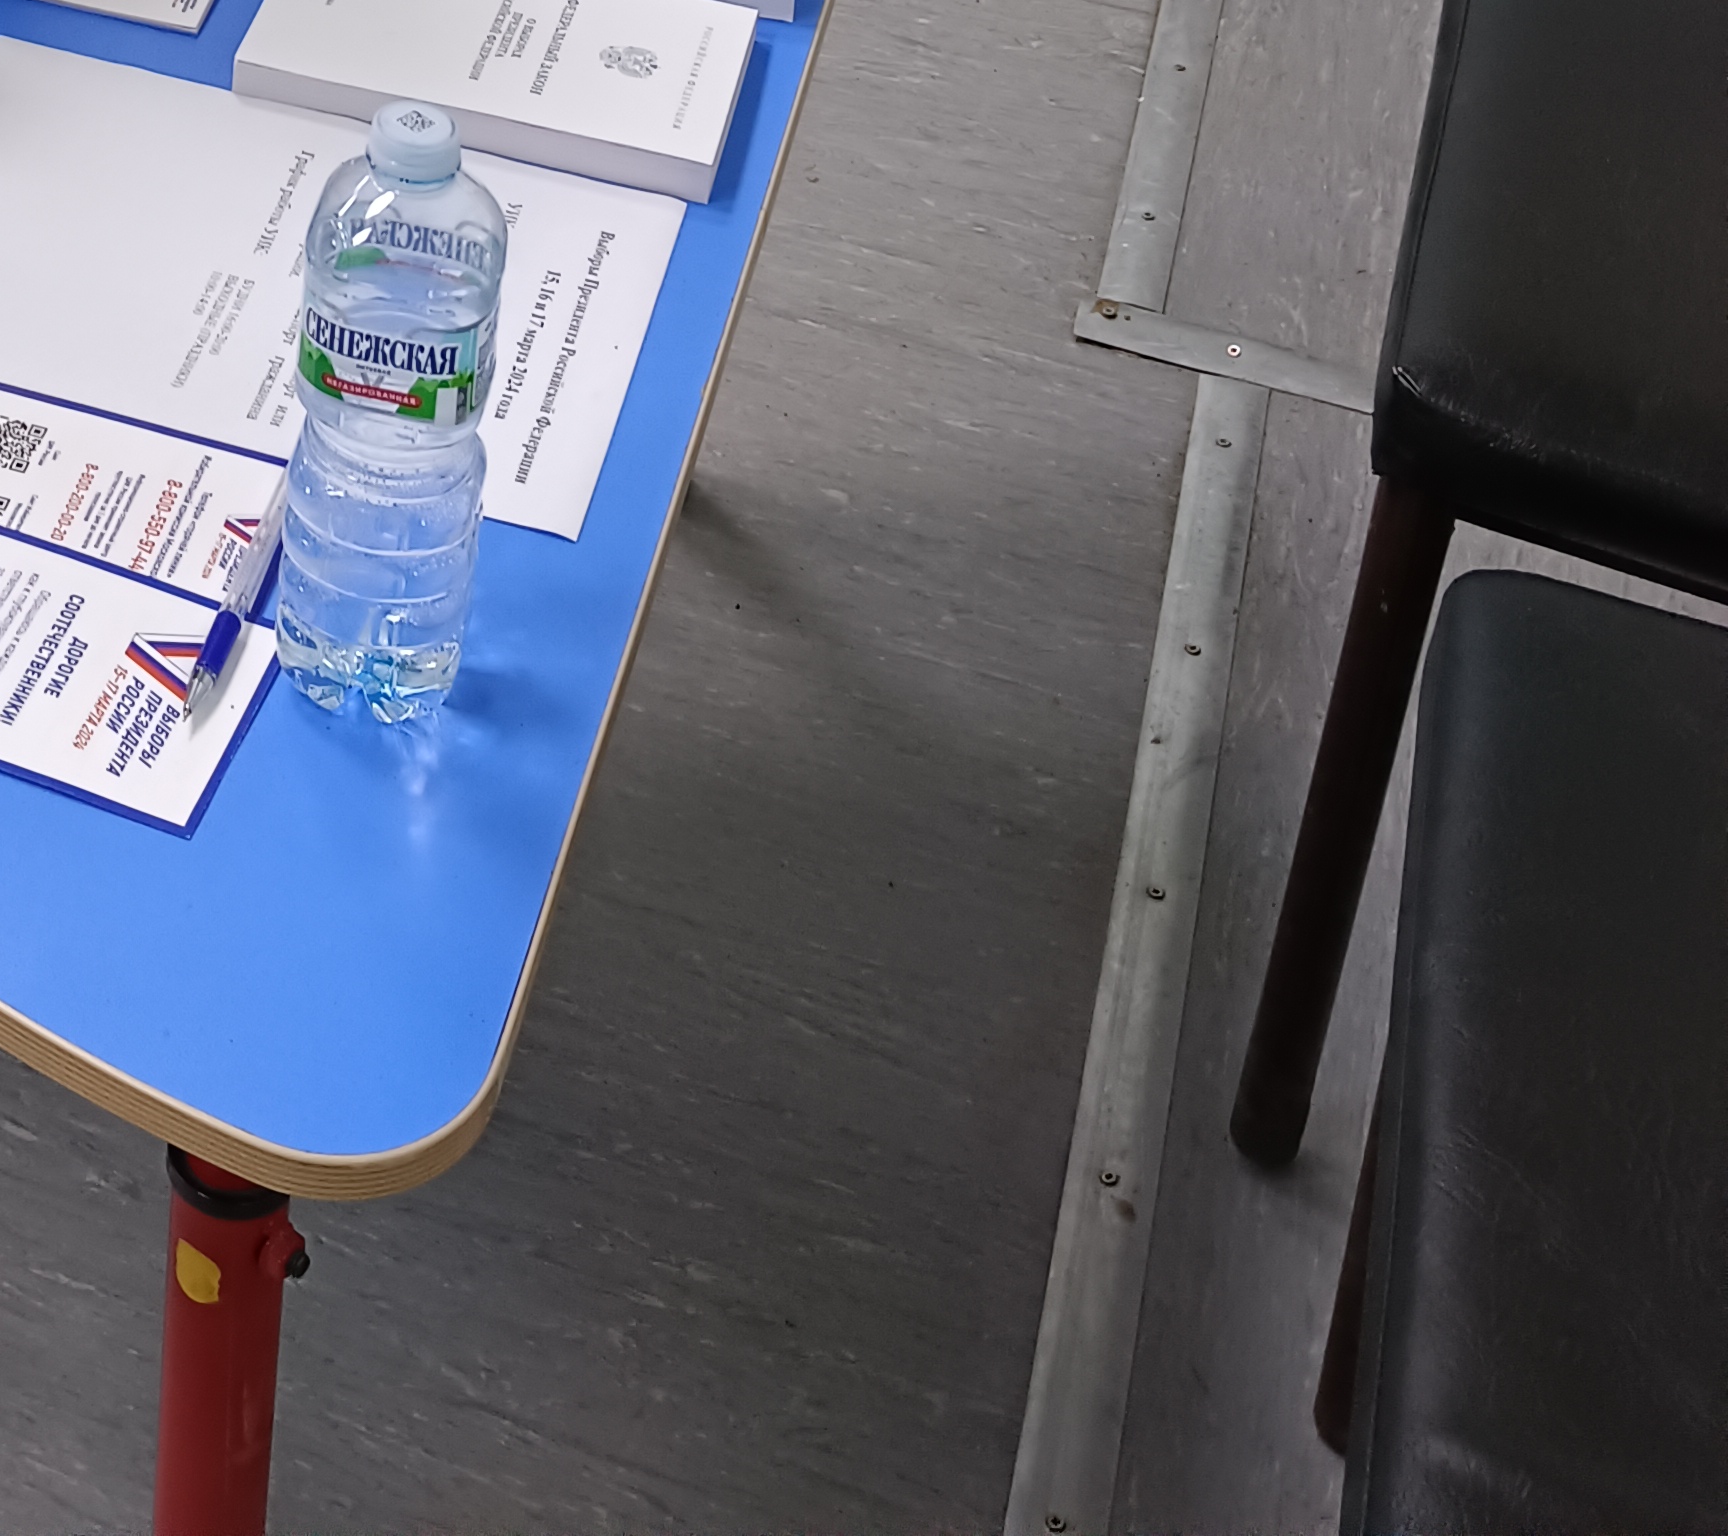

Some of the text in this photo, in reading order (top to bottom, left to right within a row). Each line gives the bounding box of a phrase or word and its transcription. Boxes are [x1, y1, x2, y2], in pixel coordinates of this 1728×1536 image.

[529, 62, 553, 95] ЗАКОН
[286, 149, 315, 188] График
[267, 187, 293, 226] работы
[305, 306, 459, 376] СЕНЕЖСКАЯ
[493, 269, 561, 419] 15, 16 и 17 марта 2024 года
[514, 230, 615, 484] Выборы Президента Российской Федерации
[326, 376, 417, 406] НЕГАЗИРОВАННАЯ
[127, 479, 182, 570] 8-800-550-97-44
[43, 636, 88, 697] ДОРОГИЕ
[85, 690, 113, 726] МАРТА
[105, 675, 145, 733] РОССИИ
[106, 690, 162, 776] ПРЕЗИДЕНТА
[72, 722, 94, 750] 2024
[138, 704, 184, 768] ВЫБОРЫ
